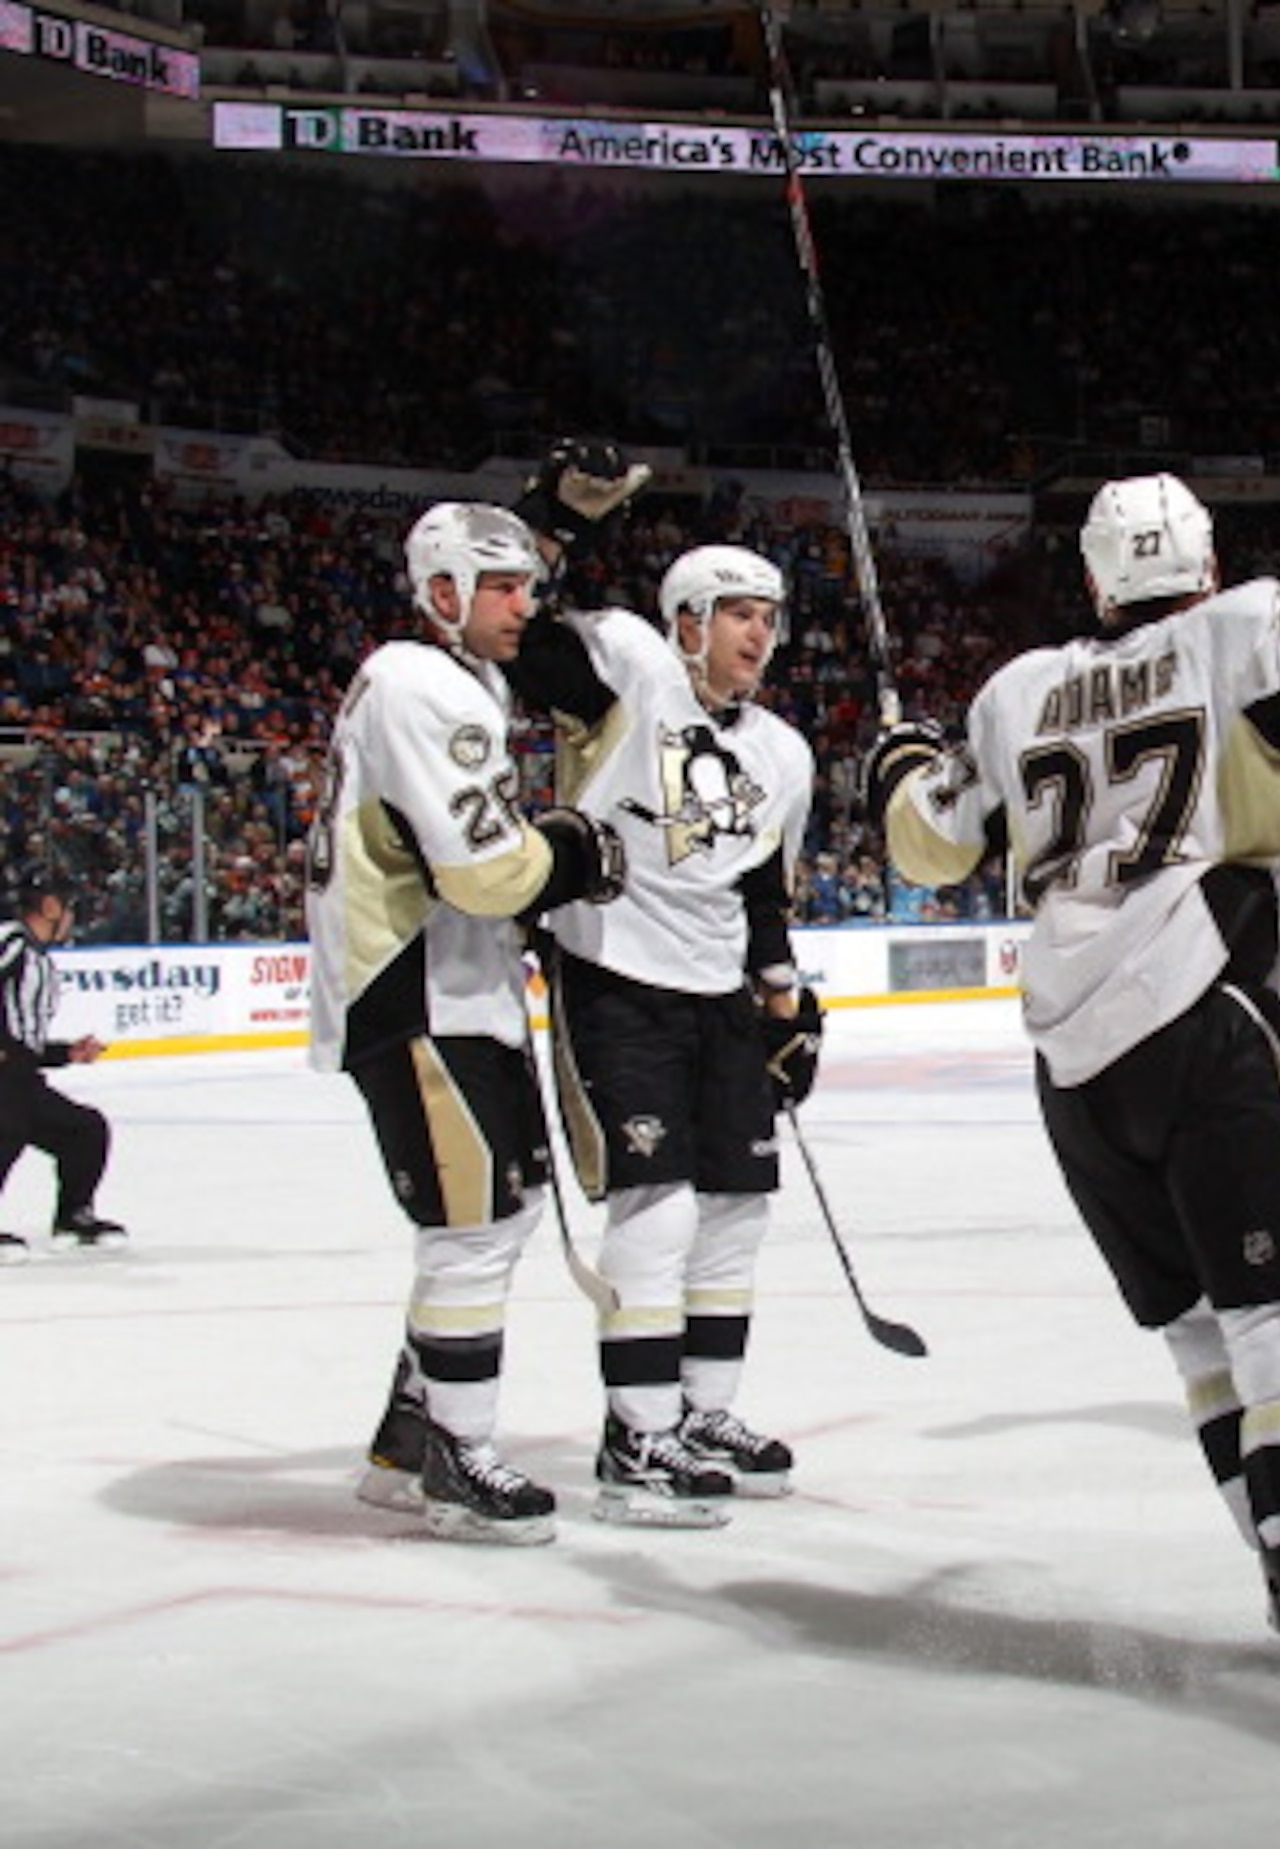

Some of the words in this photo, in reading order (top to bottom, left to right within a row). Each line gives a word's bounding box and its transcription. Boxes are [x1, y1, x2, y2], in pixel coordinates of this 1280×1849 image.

[86, 30, 168, 84] Bank
[357, 118, 478, 152] Bank
[559, 130, 735, 165] America's
[750, 138, 841, 169] Most
[853, 139, 1068, 173] Convenient
[1132, 530, 1160, 558] 27
[1018, 706, 1205, 905] 27
